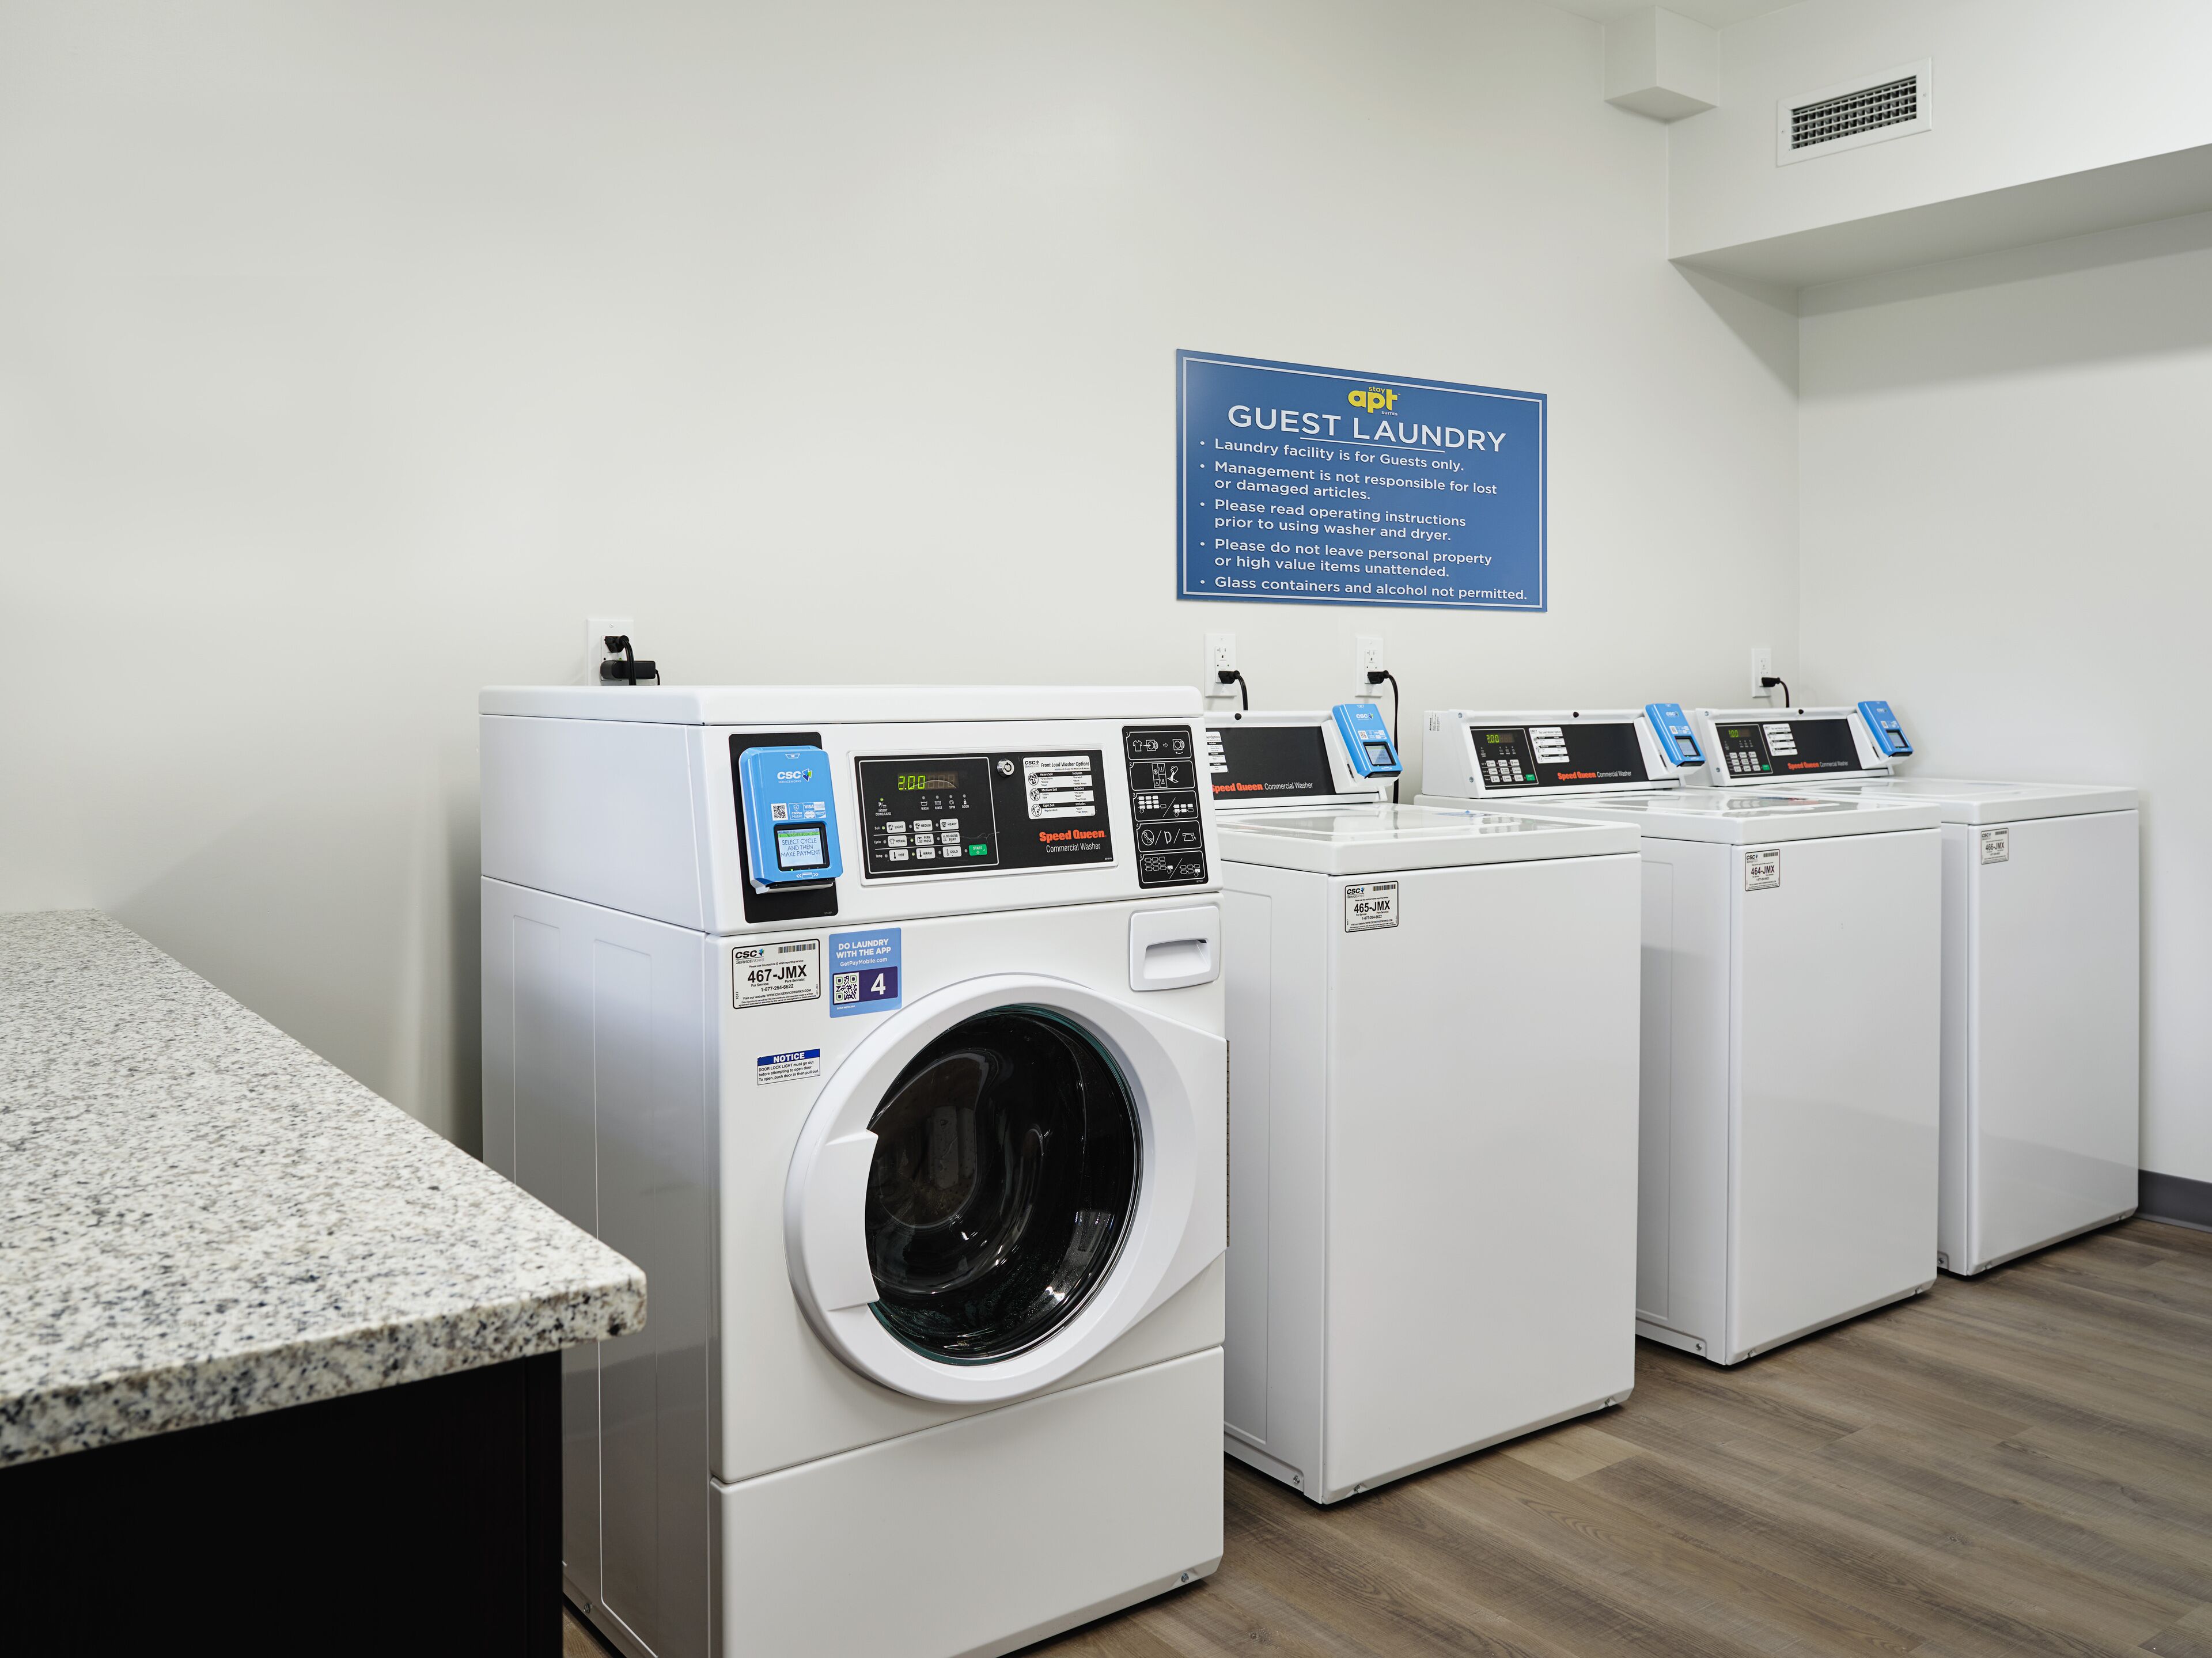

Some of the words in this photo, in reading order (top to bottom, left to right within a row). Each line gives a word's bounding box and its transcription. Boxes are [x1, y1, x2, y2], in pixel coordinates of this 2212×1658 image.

[1348, 389, 1398, 413] apt
[1228, 405, 1341, 436] GUEST
[1354, 418, 1506, 452] LAUNDRY
[1215, 438, 1279, 456] Laundry
[1284, 445, 1334, 461] facility
[1339, 450, 1350, 461] is
[1355, 452, 1375, 463] for
[1380, 454, 1427, 468] Guests
[1431, 460, 1464, 472] only.
[1215, 461, 1315, 480] Management
[1320, 470, 1331, 481] is
[1336, 473, 1359, 484] not
[1365, 476, 1445, 490] responsible
[1449, 481, 1469, 492] for
[1473, 483, 1497, 494] lost
[1214, 480, 1231, 489] or
[1236, 480, 1308, 496] damaged
[1313, 487, 1370, 500] articles.
[1215, 499, 1266, 513] Please
[1270, 505, 1304, 515] read
[1309, 507, 1380, 523] operating
[1385, 511, 1466, 526] instructions
[1215, 517, 1253, 529] prior
[1258, 519, 1274, 530] to
[1279, 521, 1319, 534] using
[1324, 525, 1376, 536] washer
[1380, 528, 1406, 538] and
[1411, 529, 1451, 541] dryer.
[1215, 538, 1266, 552] Please
[1270, 542, 1290, 553] do
[1296, 545, 1320, 555] not
[1325, 545, 1363, 557] leave
[1368, 549, 1429, 561] personal
[1433, 552, 1492, 566] property
[1214, 557, 1232, 567] or
[1237, 556, 1270, 570] high
[1275, 559, 1316, 571] value
[1320, 560, 1360, 573] items
[1365, 564, 1449, 577] unattended.
[1215, 576, 1256, 589] Glass
[1262, 580, 1340, 592] containers
[1344, 583, 1372, 594] and
[1376, 583, 1427, 595] alcohol
[1431, 587, 1455, 597] not
[1459, 589, 1527, 600] permitted.
[777, 771, 801, 780] CSC
[898, 775, 926, 790] 2.00
[1558, 772, 1577, 781] Speed
[1236, 783, 1263, 791] Queen
[1039, 830, 1071, 843] Speed
[1073, 829, 1105, 839] Queen
[1046, 844, 1079, 853] Commercial
[1080, 842, 1101, 851] Washer
[1751, 865, 1775, 875] 464-JMX
[1354, 900, 1390, 913] 465-JMX
[853, 939, 889, 948] LAUNDRY
[735, 950, 757, 958] CSC
[836, 950, 857, 958] WITH
[840, 958, 888, 967] GetPayMobile.com
[748, 965, 807, 982] 467-JMX
[870, 973, 886, 995] 4
[774, 1052, 805, 1063] NOTICE
